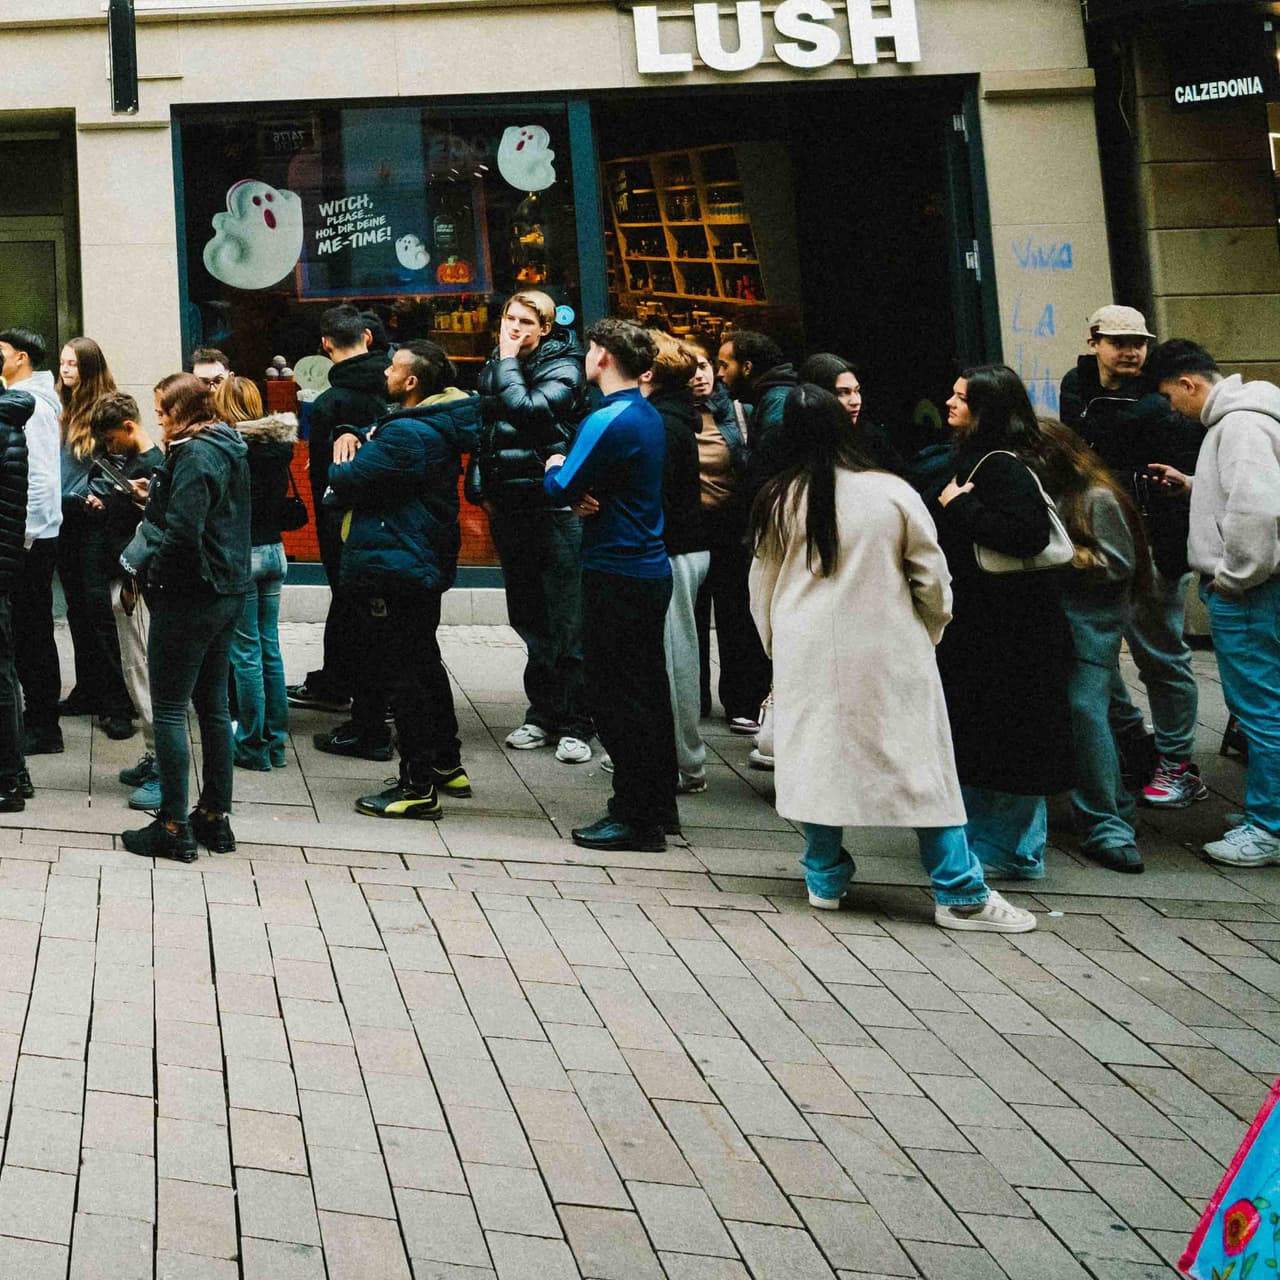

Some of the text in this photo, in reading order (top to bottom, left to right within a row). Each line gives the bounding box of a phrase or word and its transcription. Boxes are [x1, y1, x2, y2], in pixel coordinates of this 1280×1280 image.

[1175, 76, 1264, 104] CALZEDONIA
[318, 193, 374, 217] WITCH,
[327, 208, 374, 226] PLEASE...
[315, 215, 386, 239] HOL DIR DEINE
[317, 226, 392, 255] ME-TIME!
